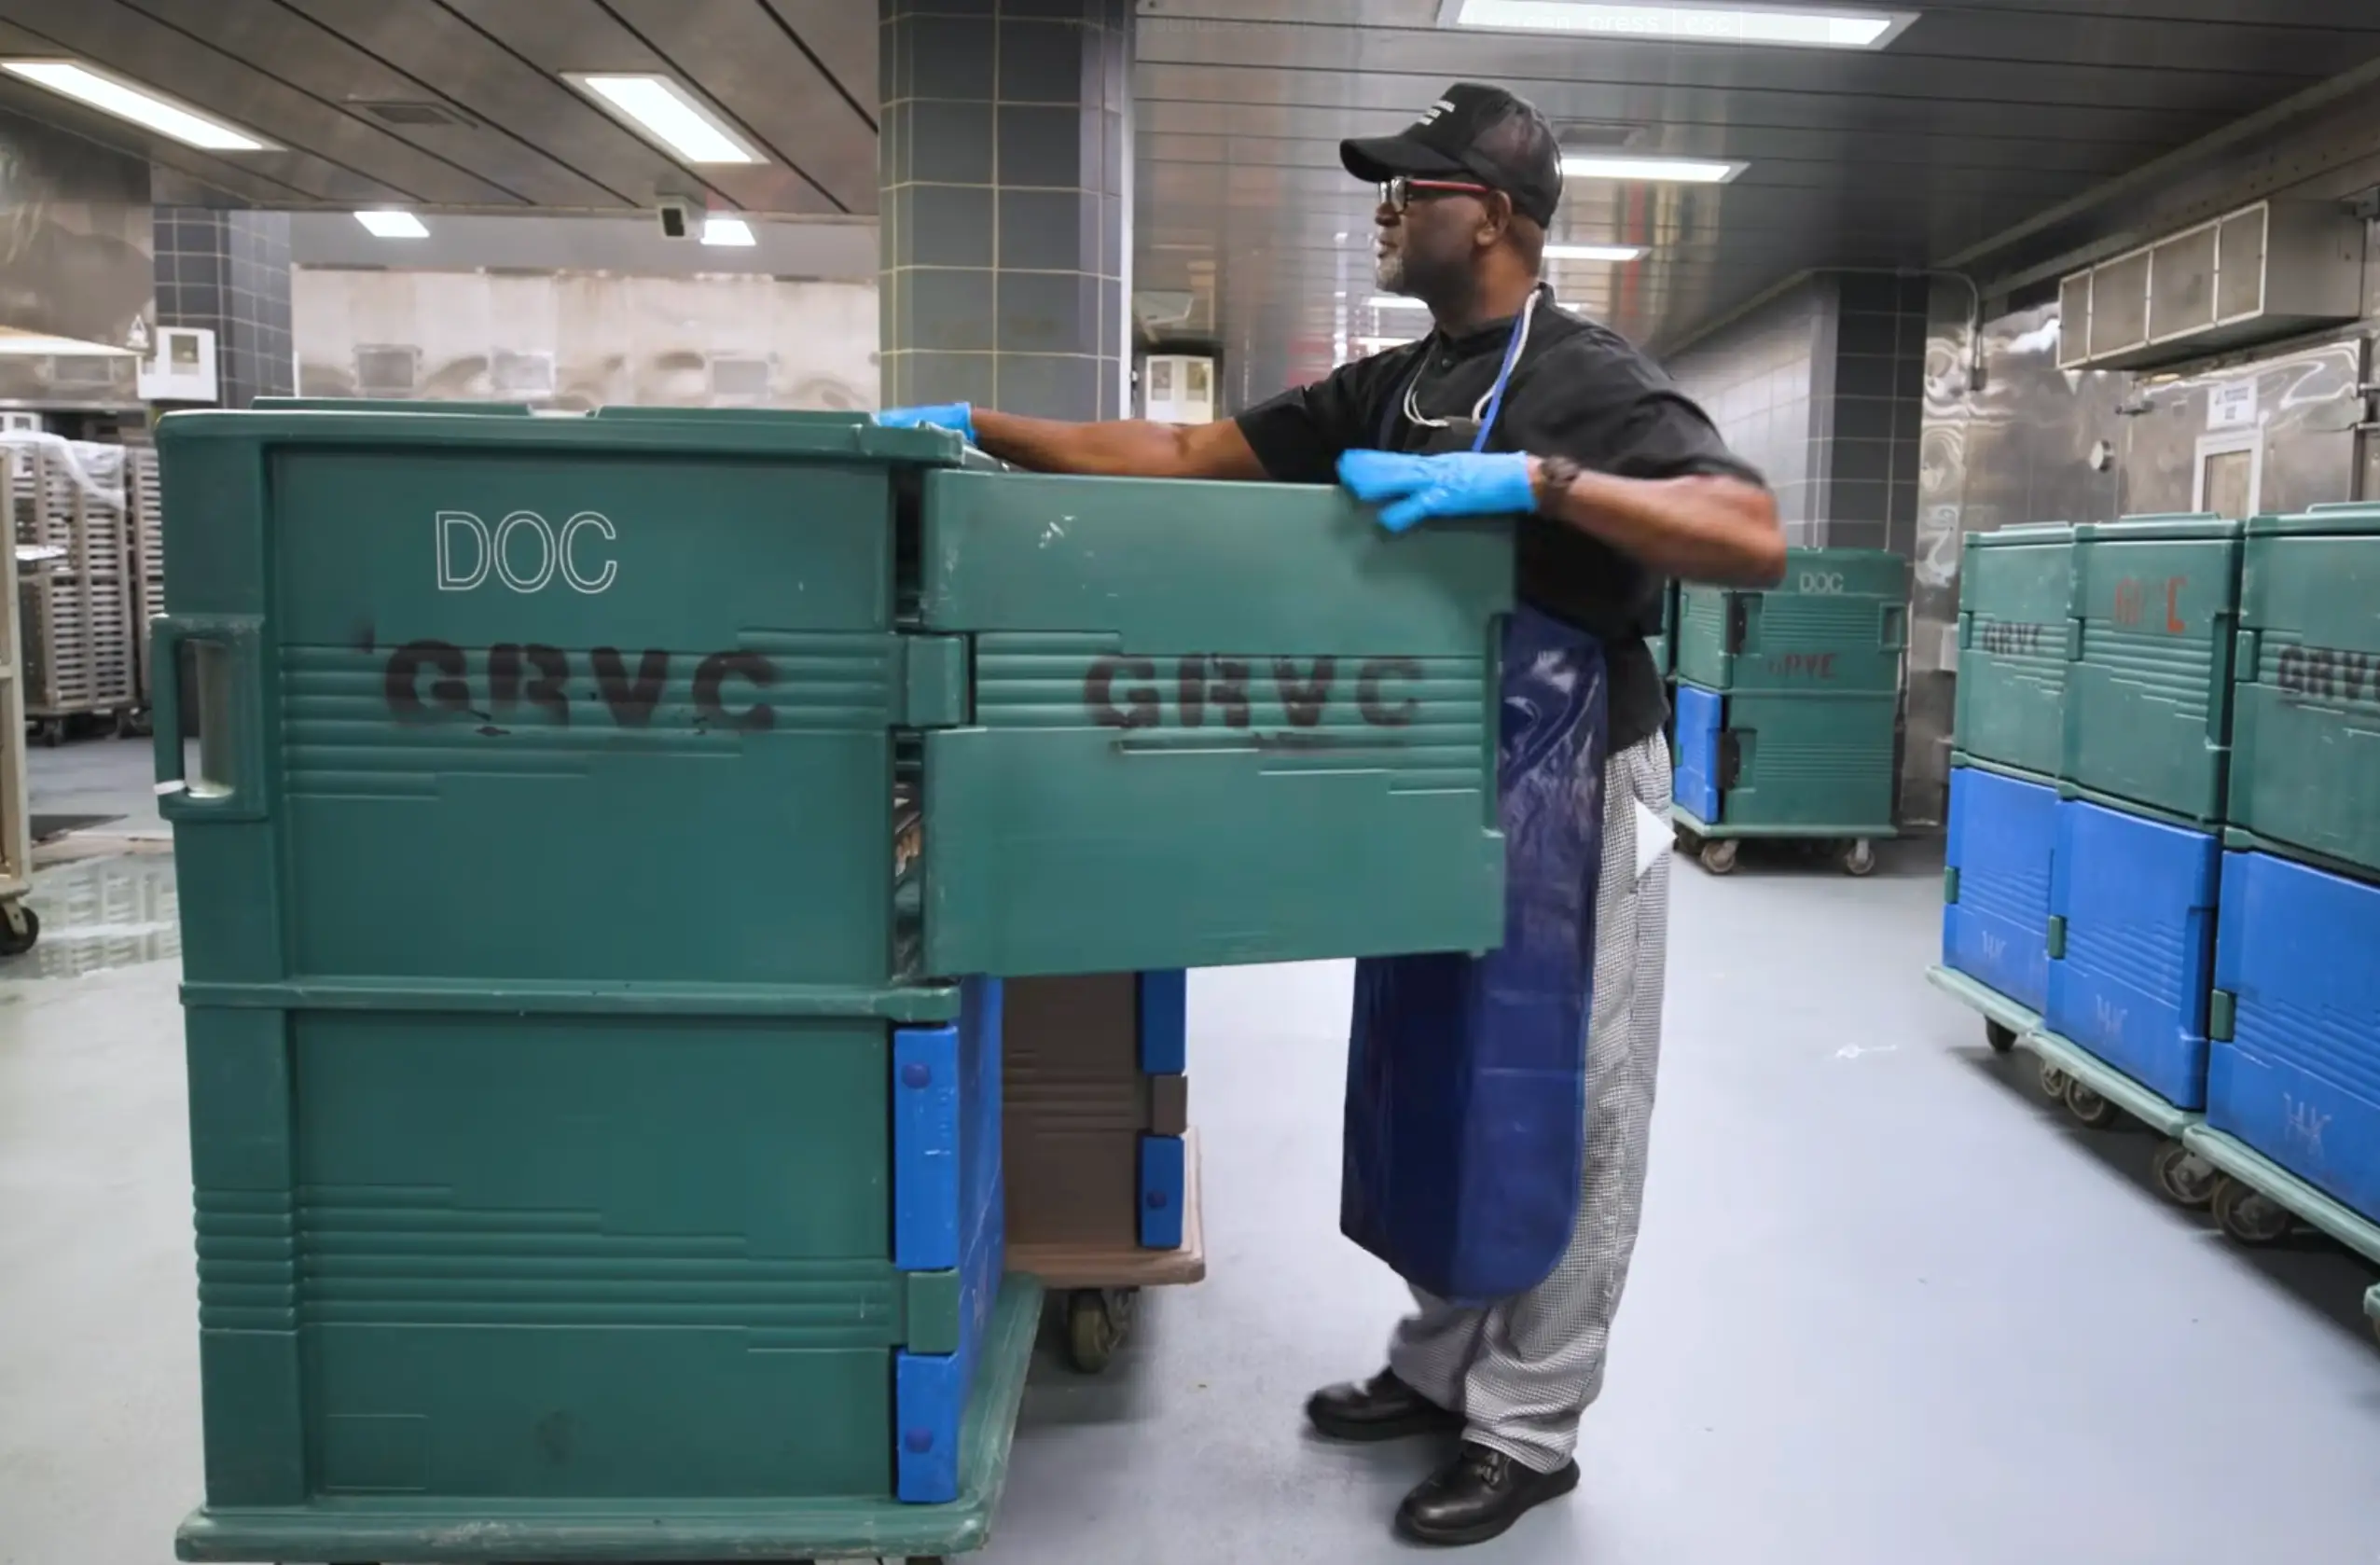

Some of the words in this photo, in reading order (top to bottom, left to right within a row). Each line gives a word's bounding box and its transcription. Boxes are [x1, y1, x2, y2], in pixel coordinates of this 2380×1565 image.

[435, 509, 618, 595] DOC
[1799, 572, 1844, 593] DOC
[384, 638, 782, 731] GRVC
[1083, 652, 1423, 728] GRVC
[2276, 644, 2380, 702] GRV
